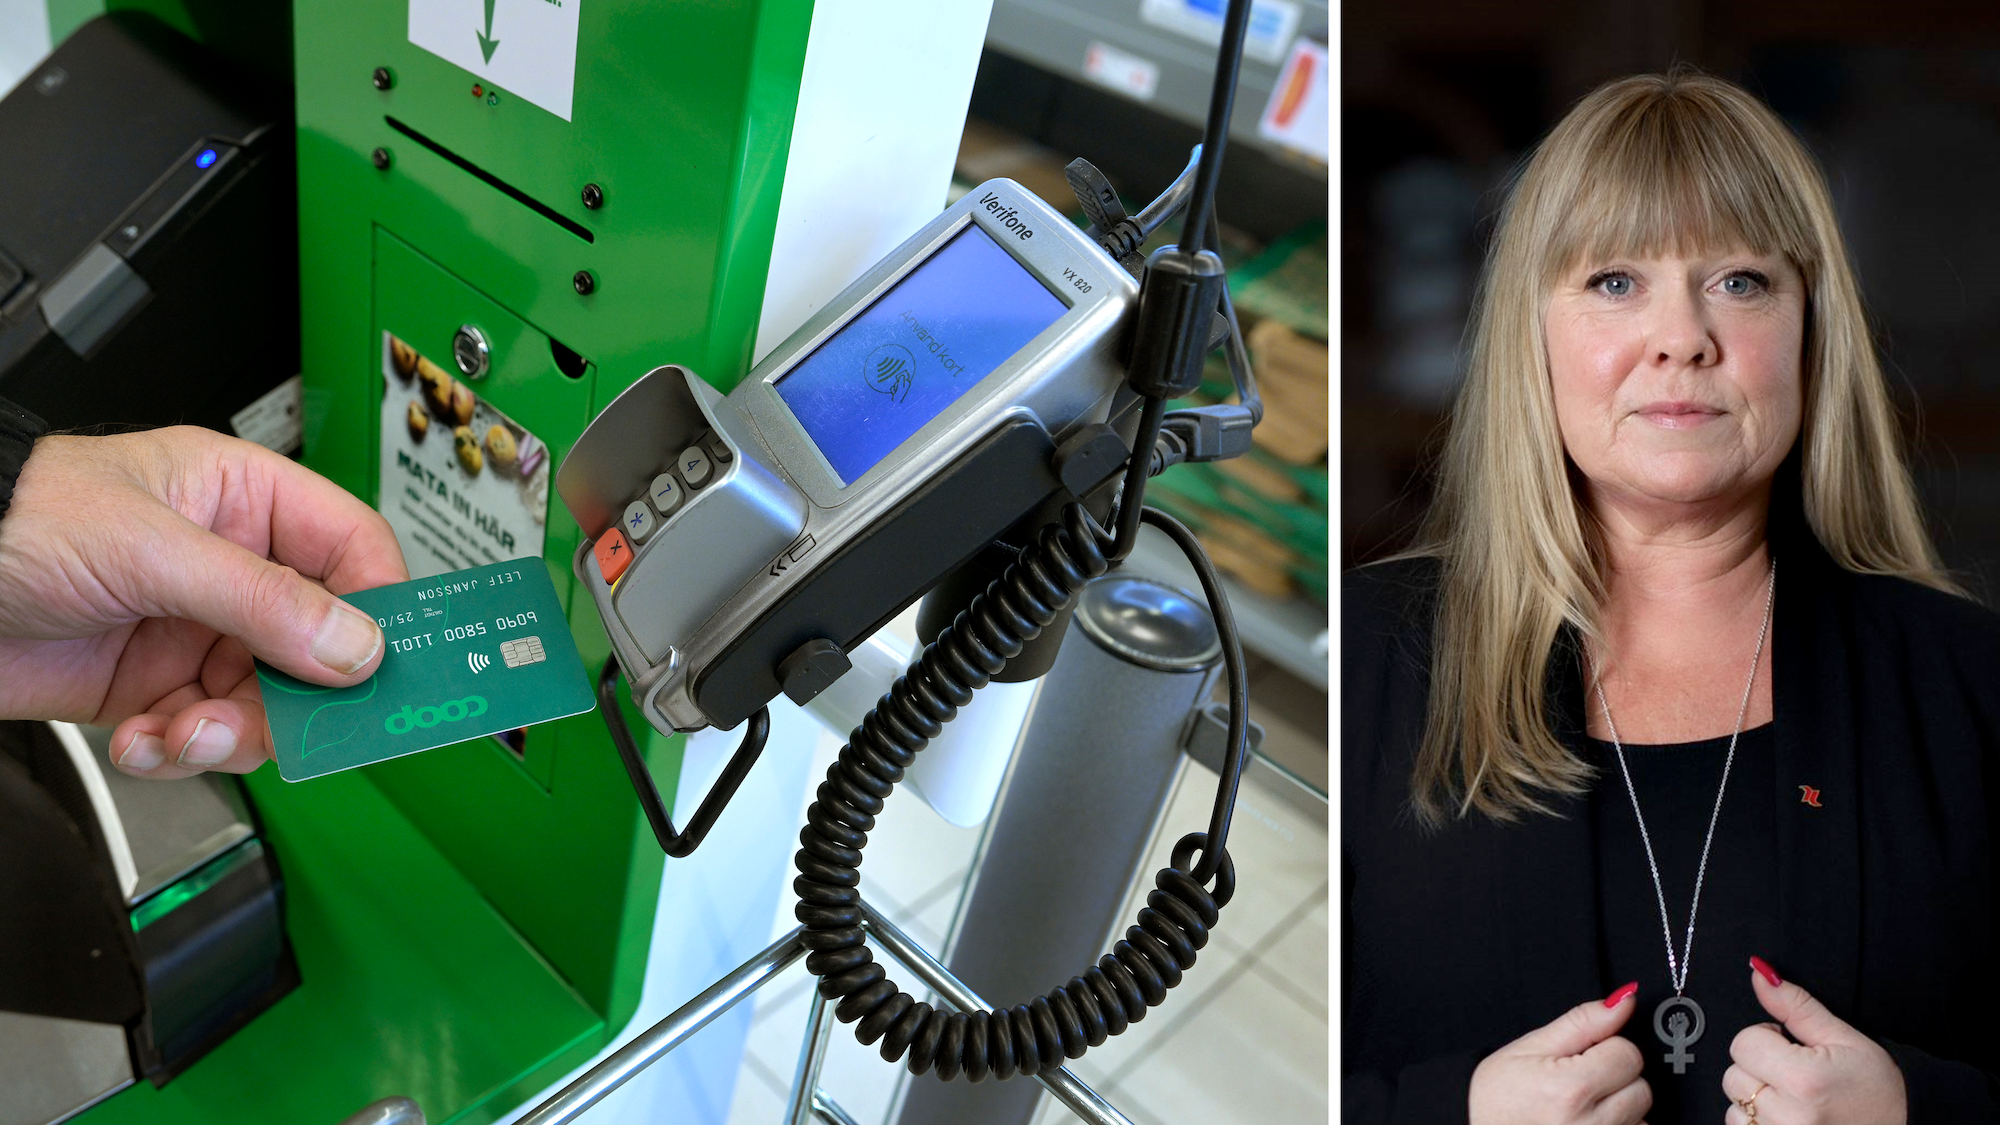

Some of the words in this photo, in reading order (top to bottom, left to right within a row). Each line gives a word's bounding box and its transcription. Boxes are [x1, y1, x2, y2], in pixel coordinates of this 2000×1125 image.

[978, 191, 1034, 241] Verifone
[1062, 266, 1075, 282] VX
[1073, 278, 1093, 294] 820
[898, 309, 946, 354] Använd
[935, 347, 967, 378] kort
[687, 459, 701, 472] 4
[657, 483, 672, 498] 7
[396, 449, 449, 501] MATA
[453, 491, 472, 520] IN
[474, 507, 516, 555] HÄR
[489, 570, 522, 587] LEIF
[417, 579, 478, 601] JANSSON
[378, 611, 414, 628] 25/0
[495, 611, 538, 631] 6090
[444, 622, 487, 642] 5800
[391, 633, 433, 654] 1101
[384, 695, 489, 735] coop
